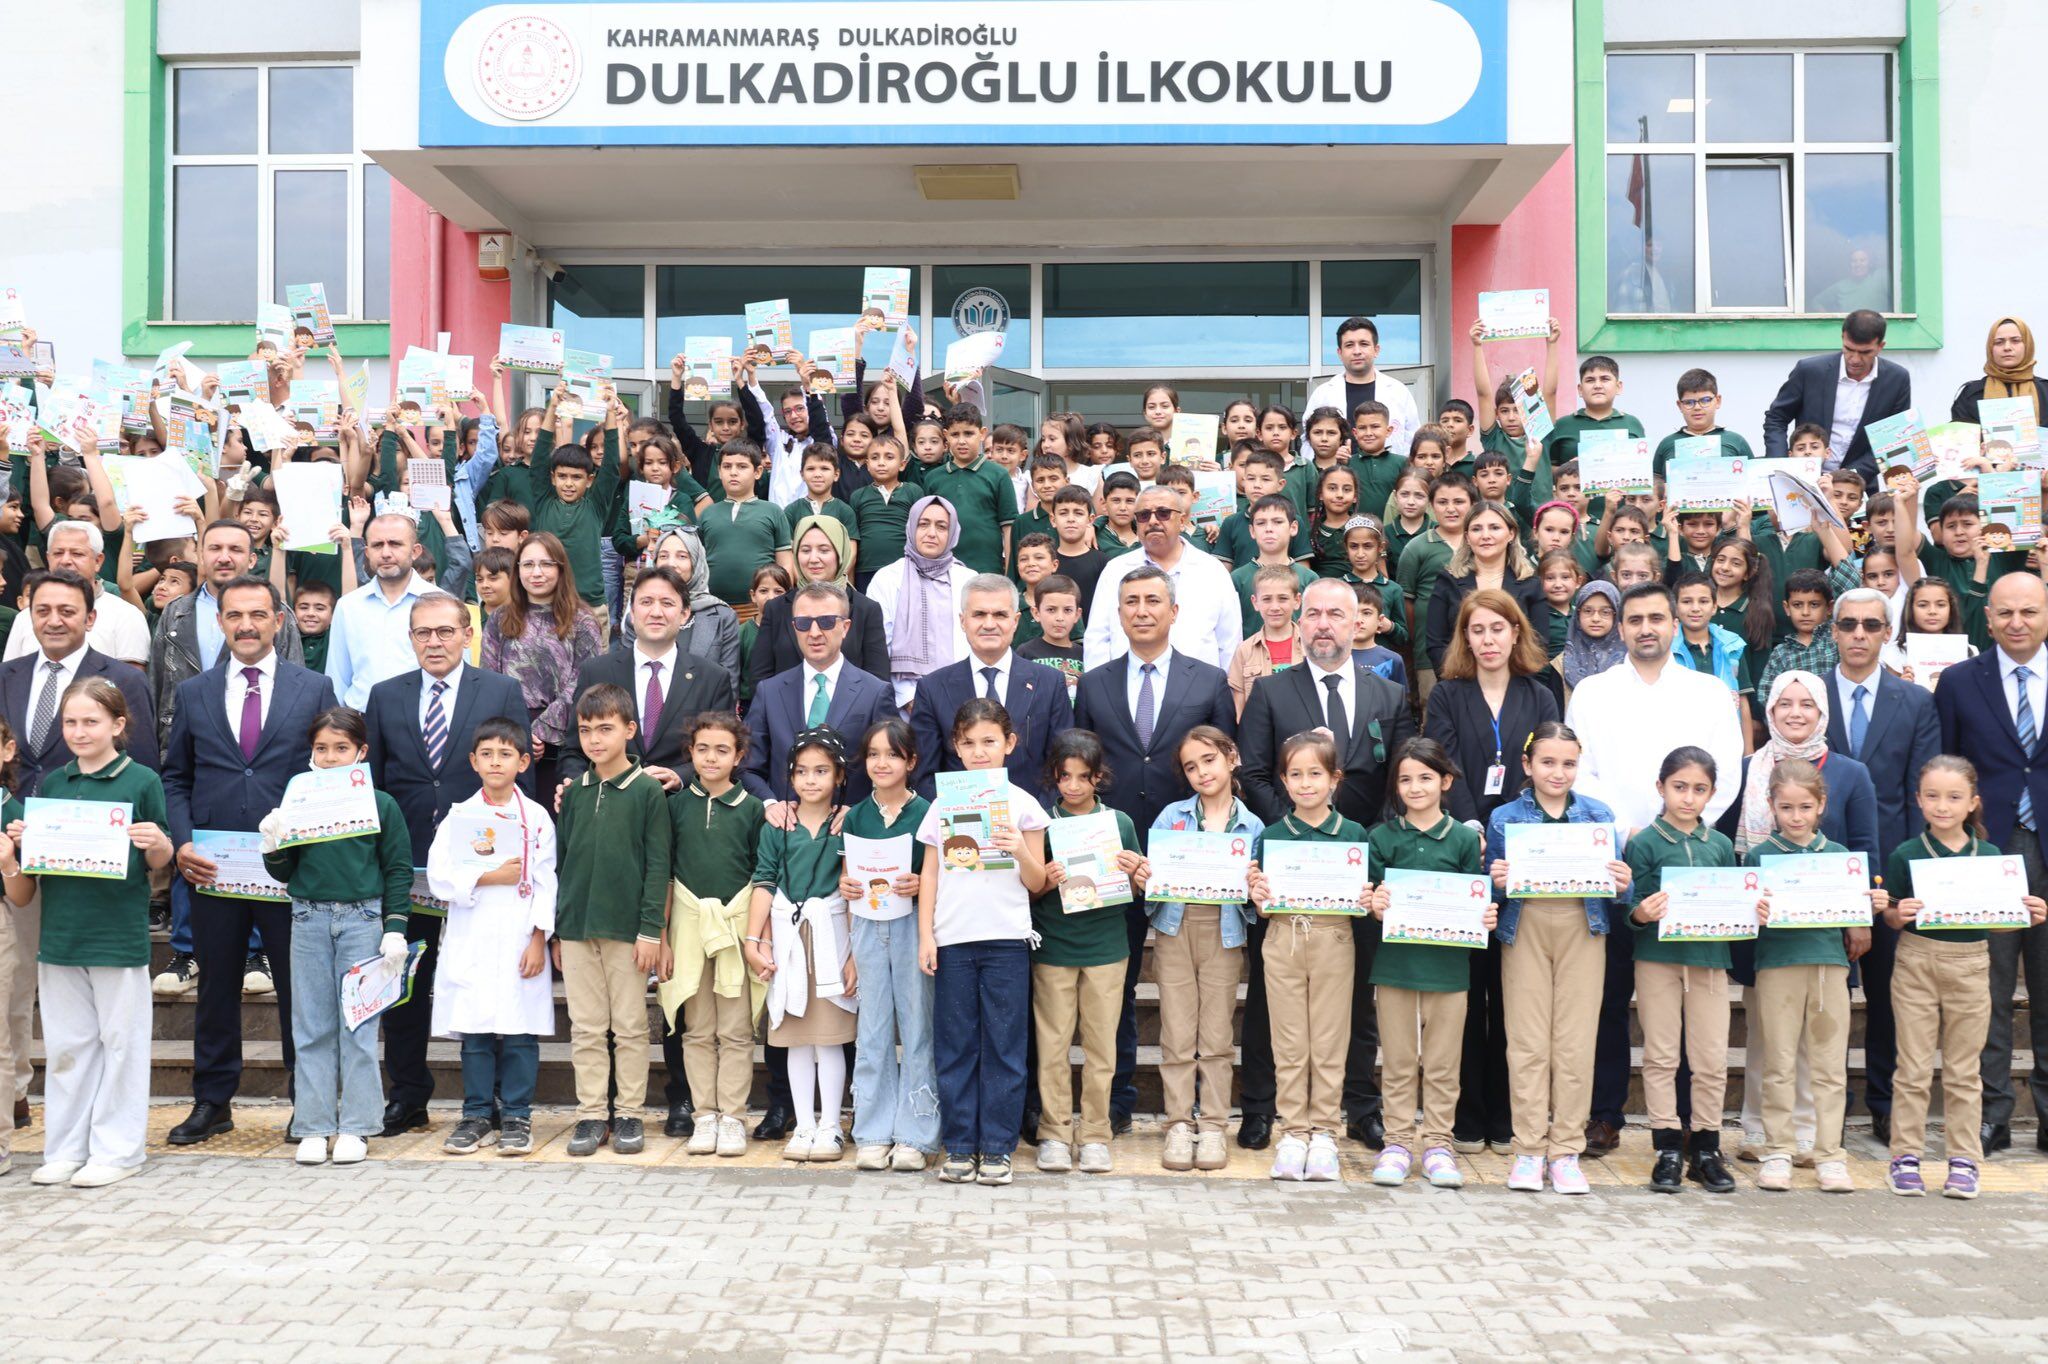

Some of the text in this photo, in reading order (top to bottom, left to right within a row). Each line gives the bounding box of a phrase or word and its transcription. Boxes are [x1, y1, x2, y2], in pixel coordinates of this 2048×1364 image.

[607, 23, 1017, 51] KAHRAMANMARAŞ DULKADİROĞLU
[606, 51, 1077, 105] DULKADİROĞLU
[1098, 51, 1392, 103] İLKOKULU
